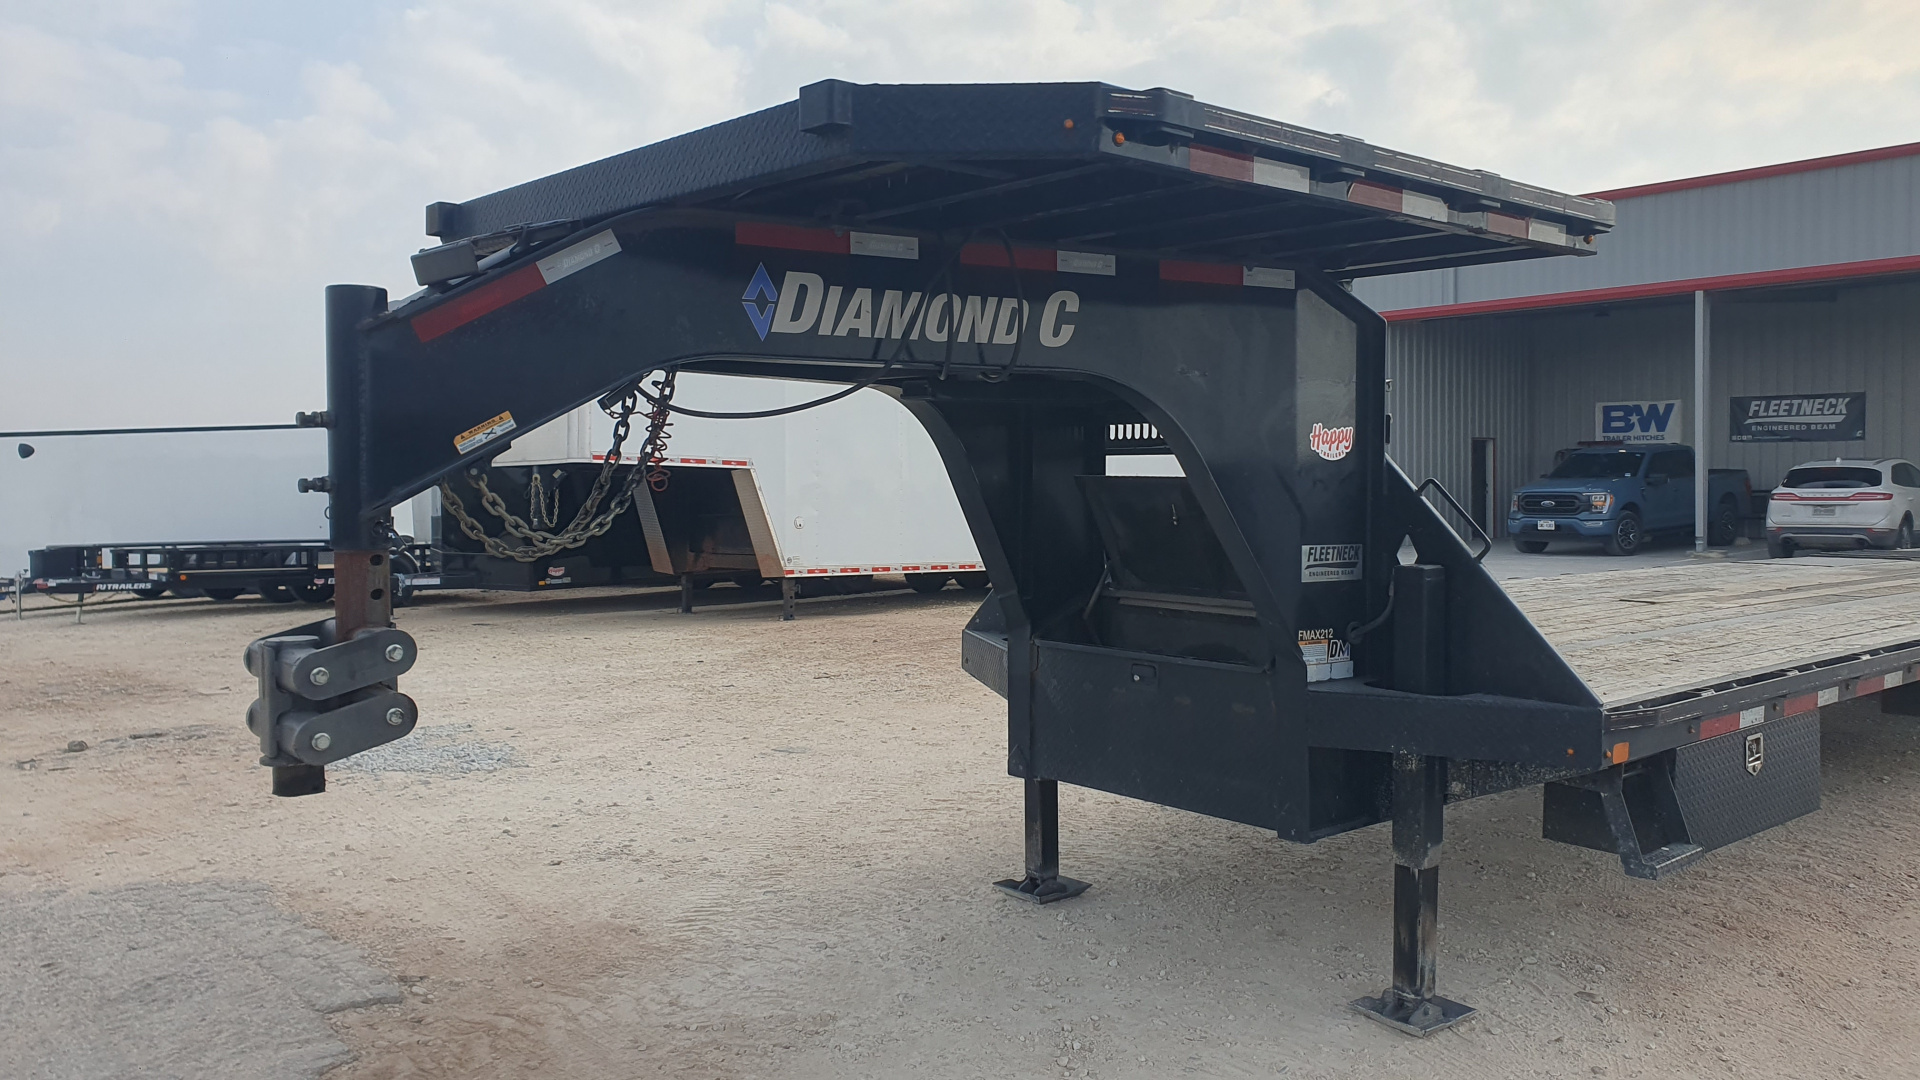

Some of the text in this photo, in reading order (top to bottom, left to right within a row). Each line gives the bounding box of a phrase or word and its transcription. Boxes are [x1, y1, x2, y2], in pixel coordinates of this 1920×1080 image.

[771, 270, 1080, 347] DIAMOND C
[1748, 397, 1851, 417] FLEETNECK
[1310, 424, 1352, 452] Happy
[1307, 545, 1361, 562] FLEETNECK
[107, 582, 152, 590] TRAILERS
[1298, 628, 1334, 641] FMAX212
